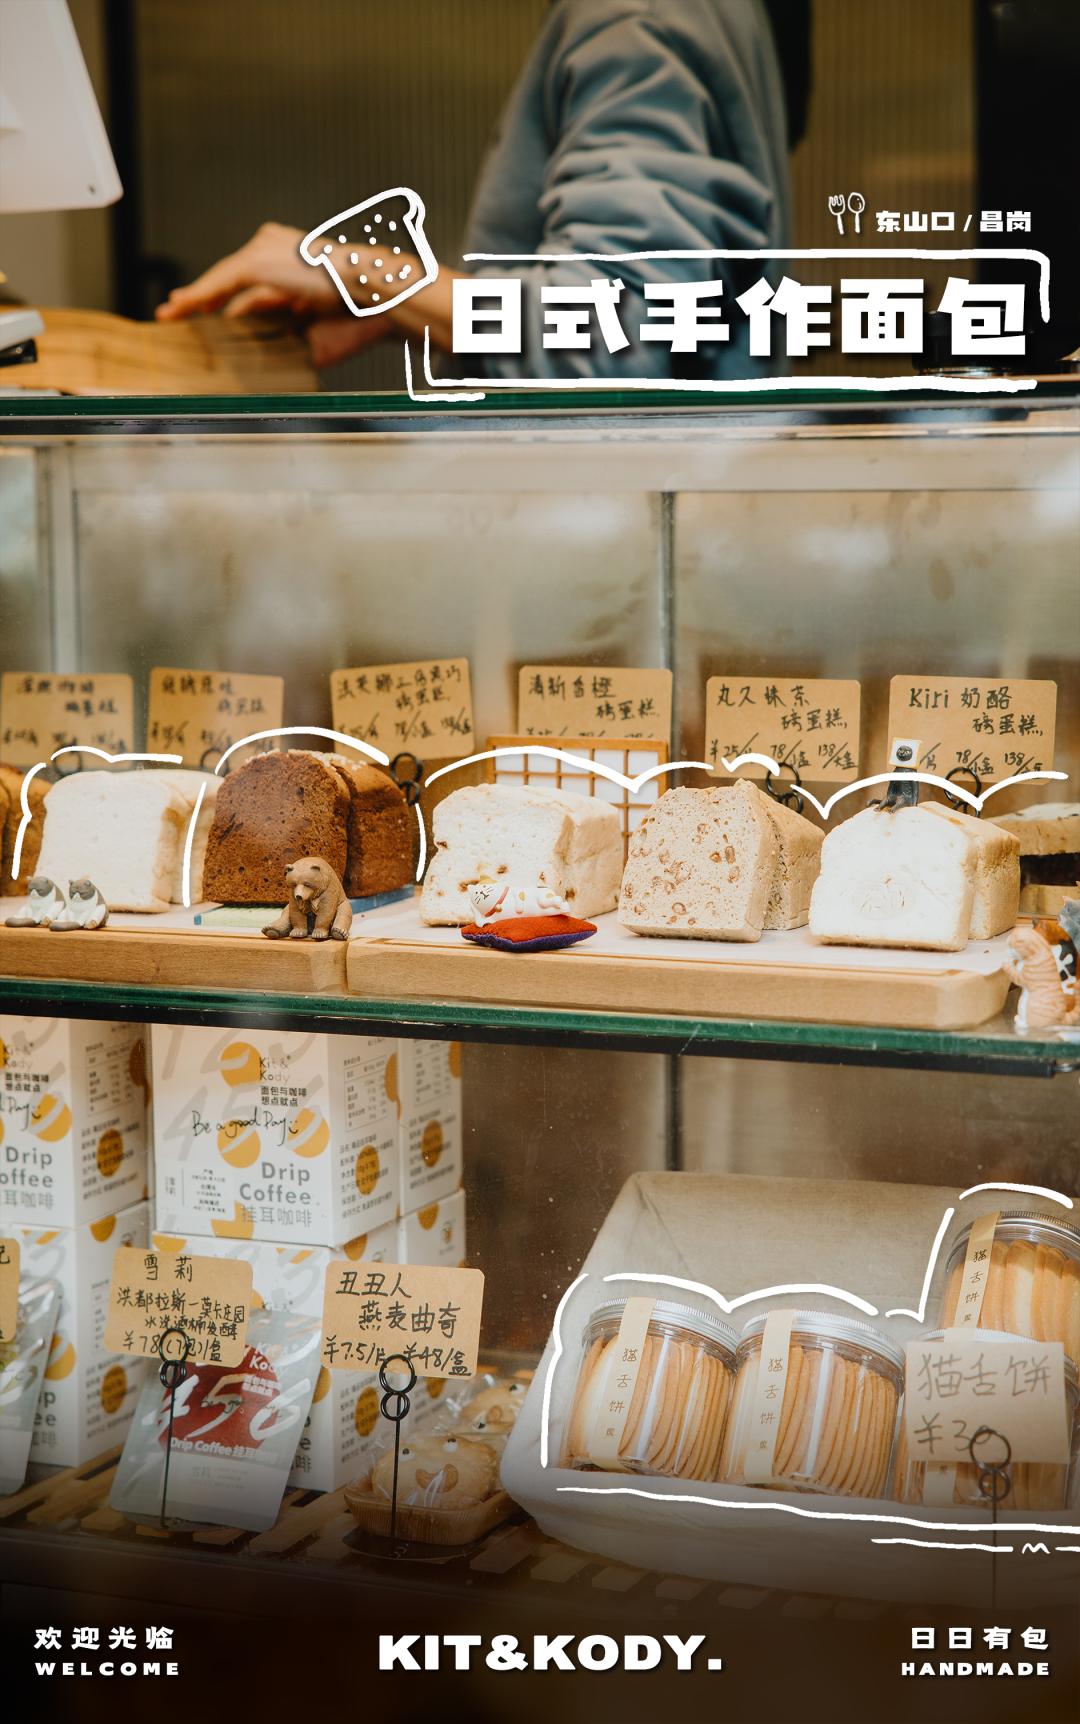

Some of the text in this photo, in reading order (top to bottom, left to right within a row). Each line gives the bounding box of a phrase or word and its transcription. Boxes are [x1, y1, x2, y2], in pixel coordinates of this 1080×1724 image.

[908, 685, 1012, 710] Kiri 奶酪
[781, 707, 849, 732] 磅蛋糕
[971, 711, 1045, 737] 磅蛋糕
[192, 1110, 212, 1137] Be
[224, 1106, 261, 1139] good
[262, 1110, 287, 1147] Day
[6, 1146, 53, 1170] Drip
[261, 1162, 311, 1186] Drip
[239, 1183, 312, 1205] Coffee
[241, 1204, 313, 1227] 挂耳咖啡
[144, 1253, 193, 1283] 雪莉
[336, 1271, 412, 1298] 丑丑人
[358, 1300, 461, 1339] 燕麦曲奇
[403, 1341, 472, 1377] ¥48/盒
[608, 1347, 638, 1414] 猫舌饼
[917, 1353, 1051, 1401] 猫舌饼
[759, 1357, 785, 1425] 猫舌饼
[171, 1437, 193, 1451] Drip
[194, 1440, 232, 1456] Coffee
